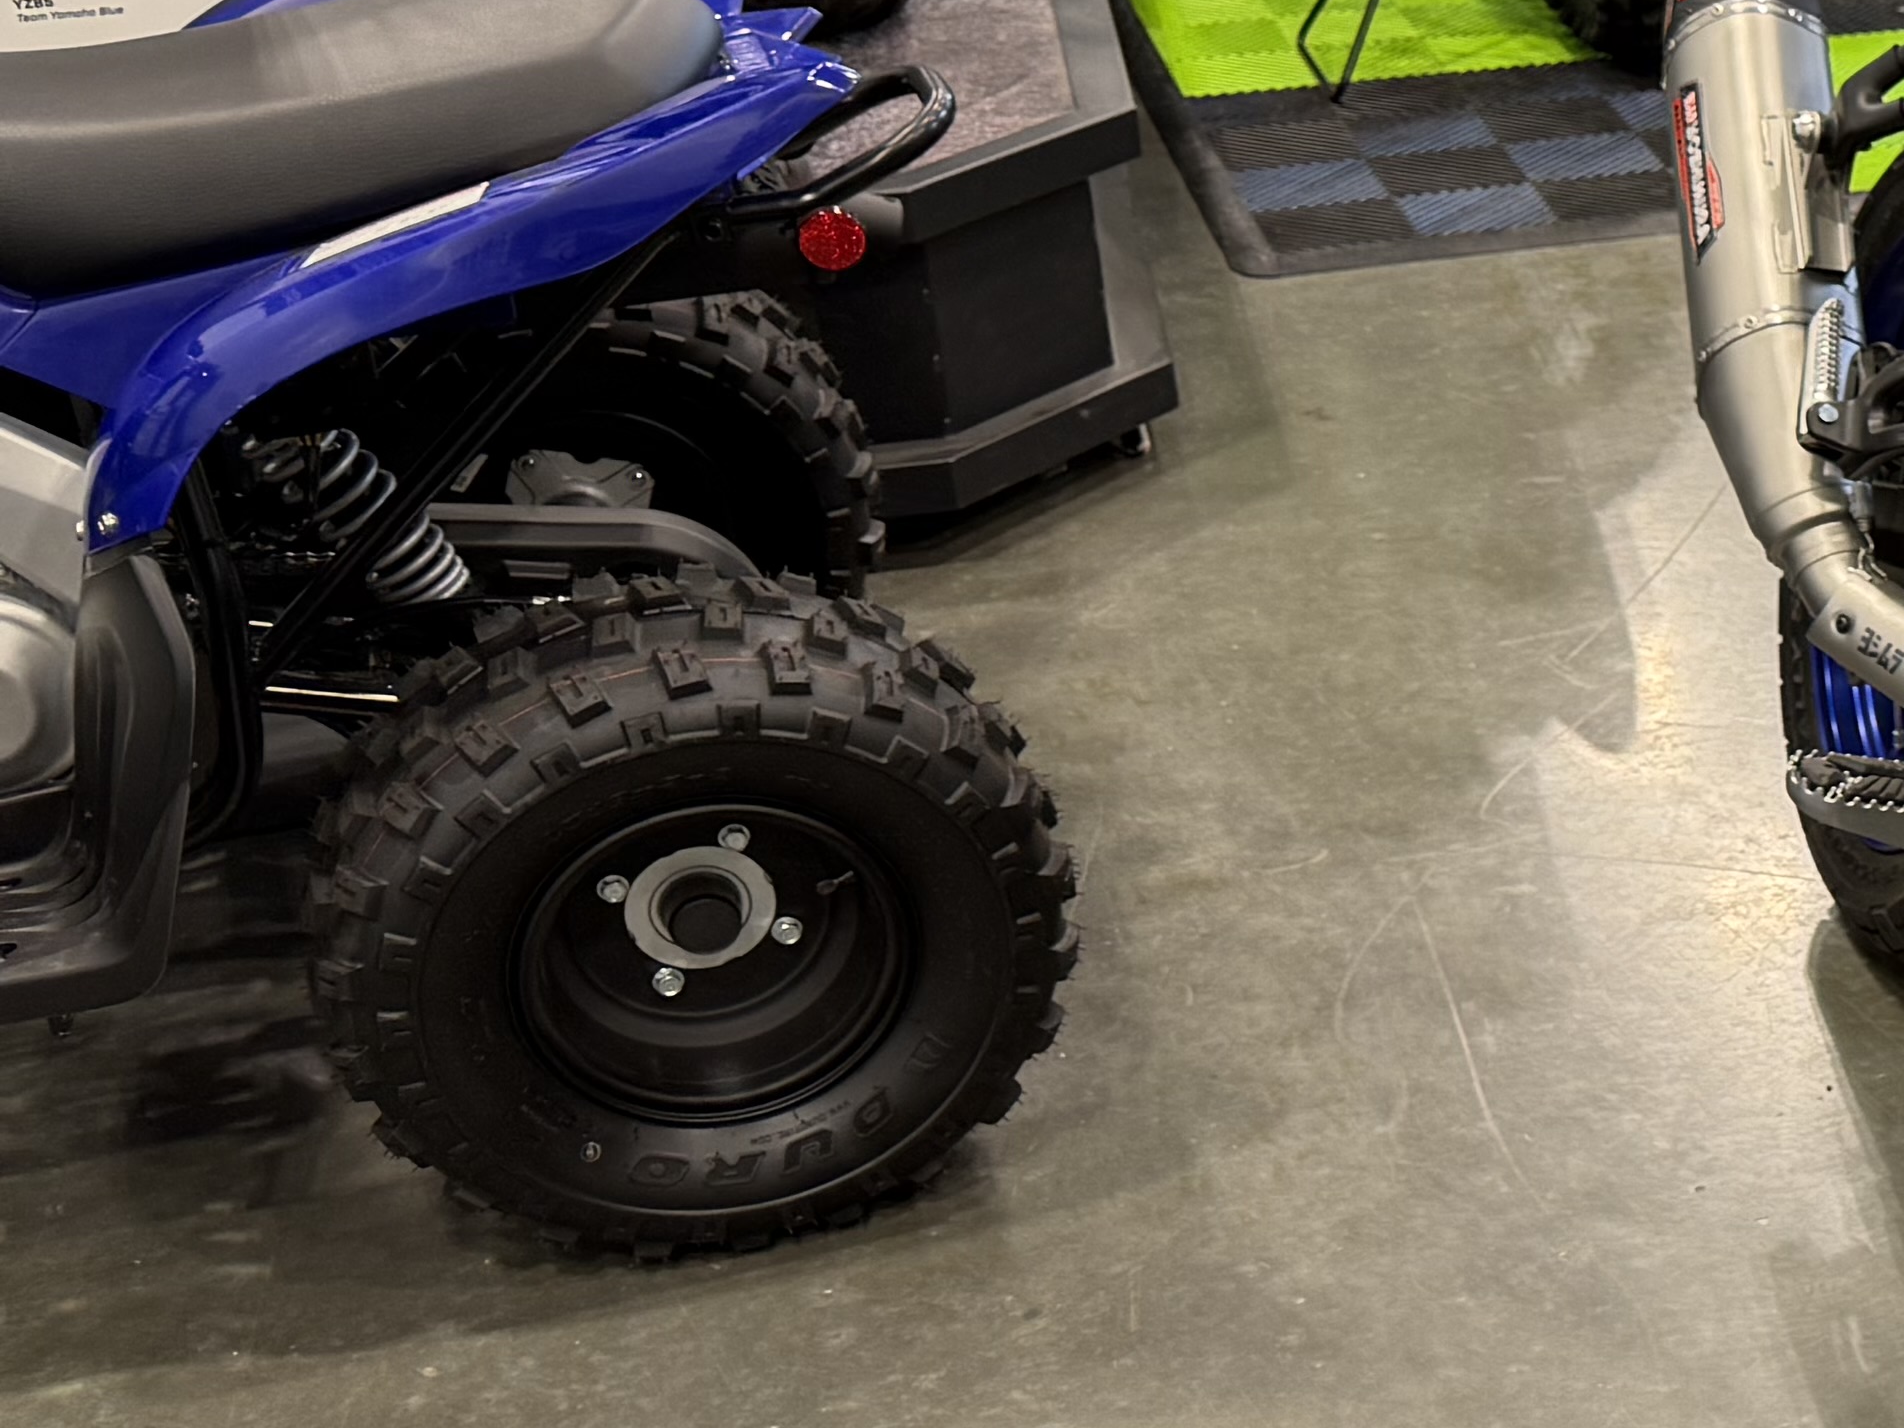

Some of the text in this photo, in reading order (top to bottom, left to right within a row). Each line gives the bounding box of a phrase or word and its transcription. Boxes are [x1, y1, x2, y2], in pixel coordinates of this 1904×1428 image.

[17, 6, 124, 24] Team Yamaha Blue
[628, 1085, 893, 1189] DURO
